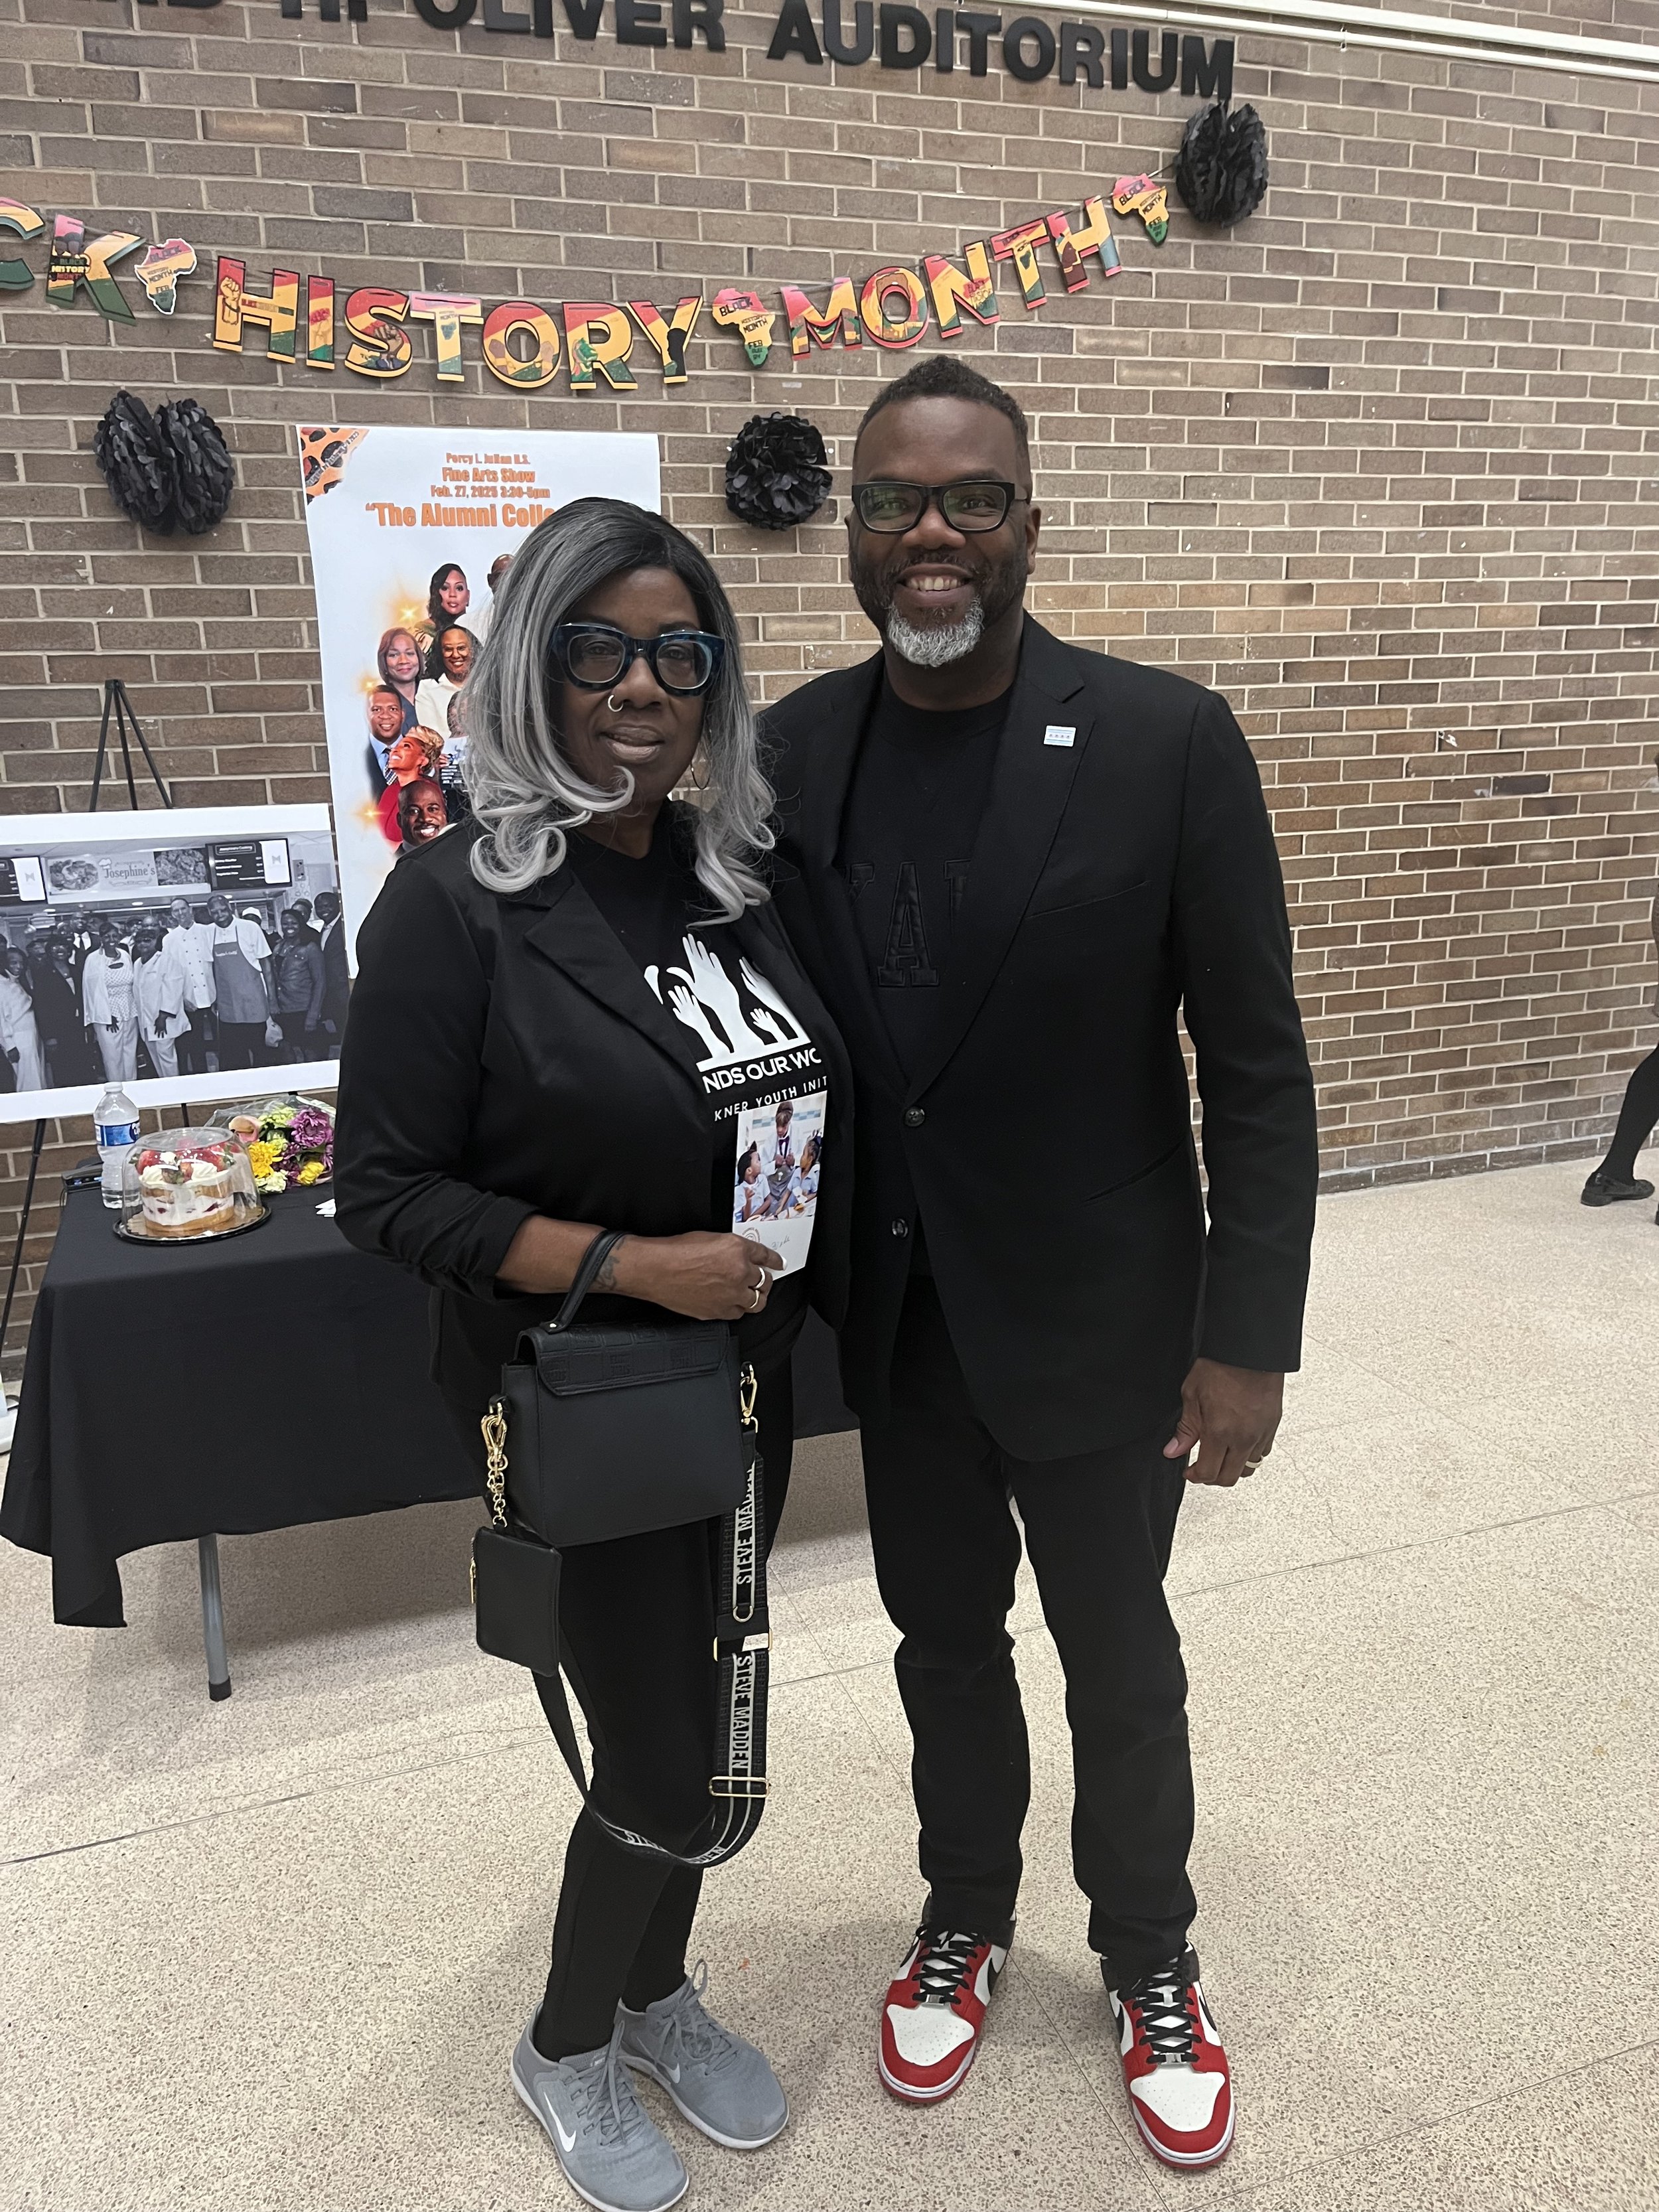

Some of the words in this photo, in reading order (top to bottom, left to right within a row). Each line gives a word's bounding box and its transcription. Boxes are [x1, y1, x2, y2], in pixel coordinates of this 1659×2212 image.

[766, 0, 1236, 100] AUDITORIUM
[213, 256, 703, 390] HISTORY
[780, 195, 1122, 360] MONTH
[719, 297, 753, 317] BLACK
[442, 467, 470, 482] Fine
[472, 467, 498, 482] Arts
[500, 468, 536, 483] Show
[446, 452, 473, 465] Percy
[475, 453, 482, 464] L.
[431, 485, 453, 498] Feb.
[455, 485, 469, 498] 27,
[470, 486, 498, 498] 2025
[421, 502, 497, 526] Alumni
[104, 865, 156, 880] Josephine's
[702, 1067, 746, 1094] NDS
[746, 1056, 792, 1080] OUR
[714, 1101, 749, 1122] KNER
[756, 1086, 797, 1108] YOUTH
[803, 1075, 828, 1093] INIT
[737, 1538, 753, 1585] STEVE
[735, 1656, 753, 1701] STEVE
[731, 1706, 751, 1769] MADDEN
